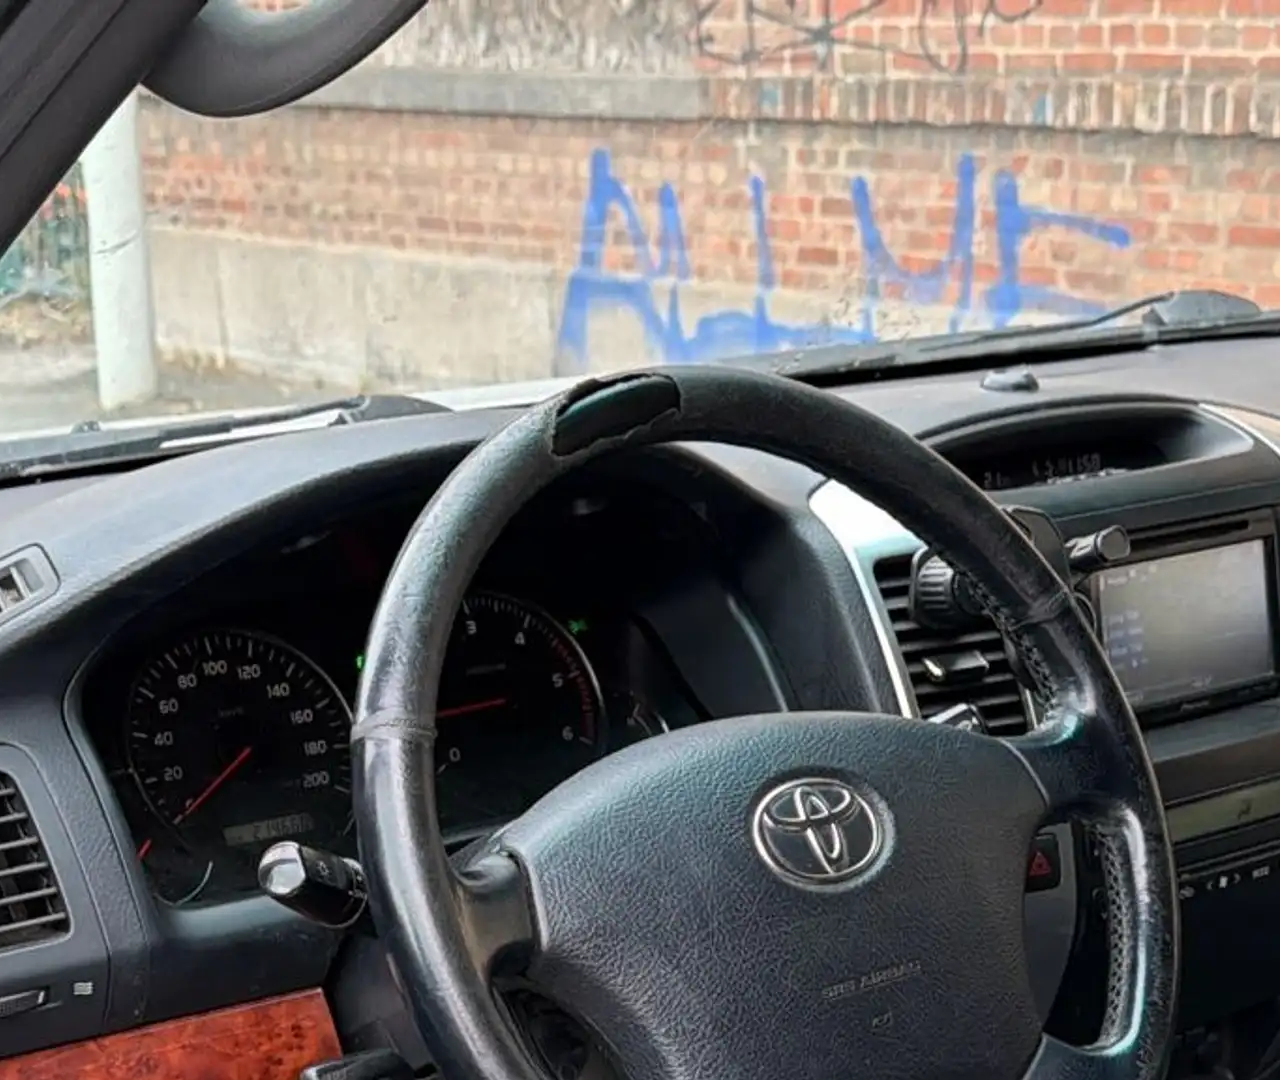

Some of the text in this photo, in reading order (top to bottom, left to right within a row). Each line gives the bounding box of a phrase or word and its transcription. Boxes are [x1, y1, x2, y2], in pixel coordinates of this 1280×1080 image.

[466, 620, 477, 635] 3
[514, 631, 526, 645] 4
[202, 659, 228, 677] 100
[237, 664, 261, 680] 120
[177, 672, 197, 689] 80
[552, 672, 563, 688] 5
[266, 682, 291, 699] 140
[159, 698, 179, 715] 60
[290, 708, 313, 725] 160
[154, 731, 174, 747] 40
[562, 725, 574, 741] 6
[304, 740, 328, 755] 180
[449, 747, 461, 762] 0
[164, 766, 183, 781] 20
[302, 770, 330, 789] 200
